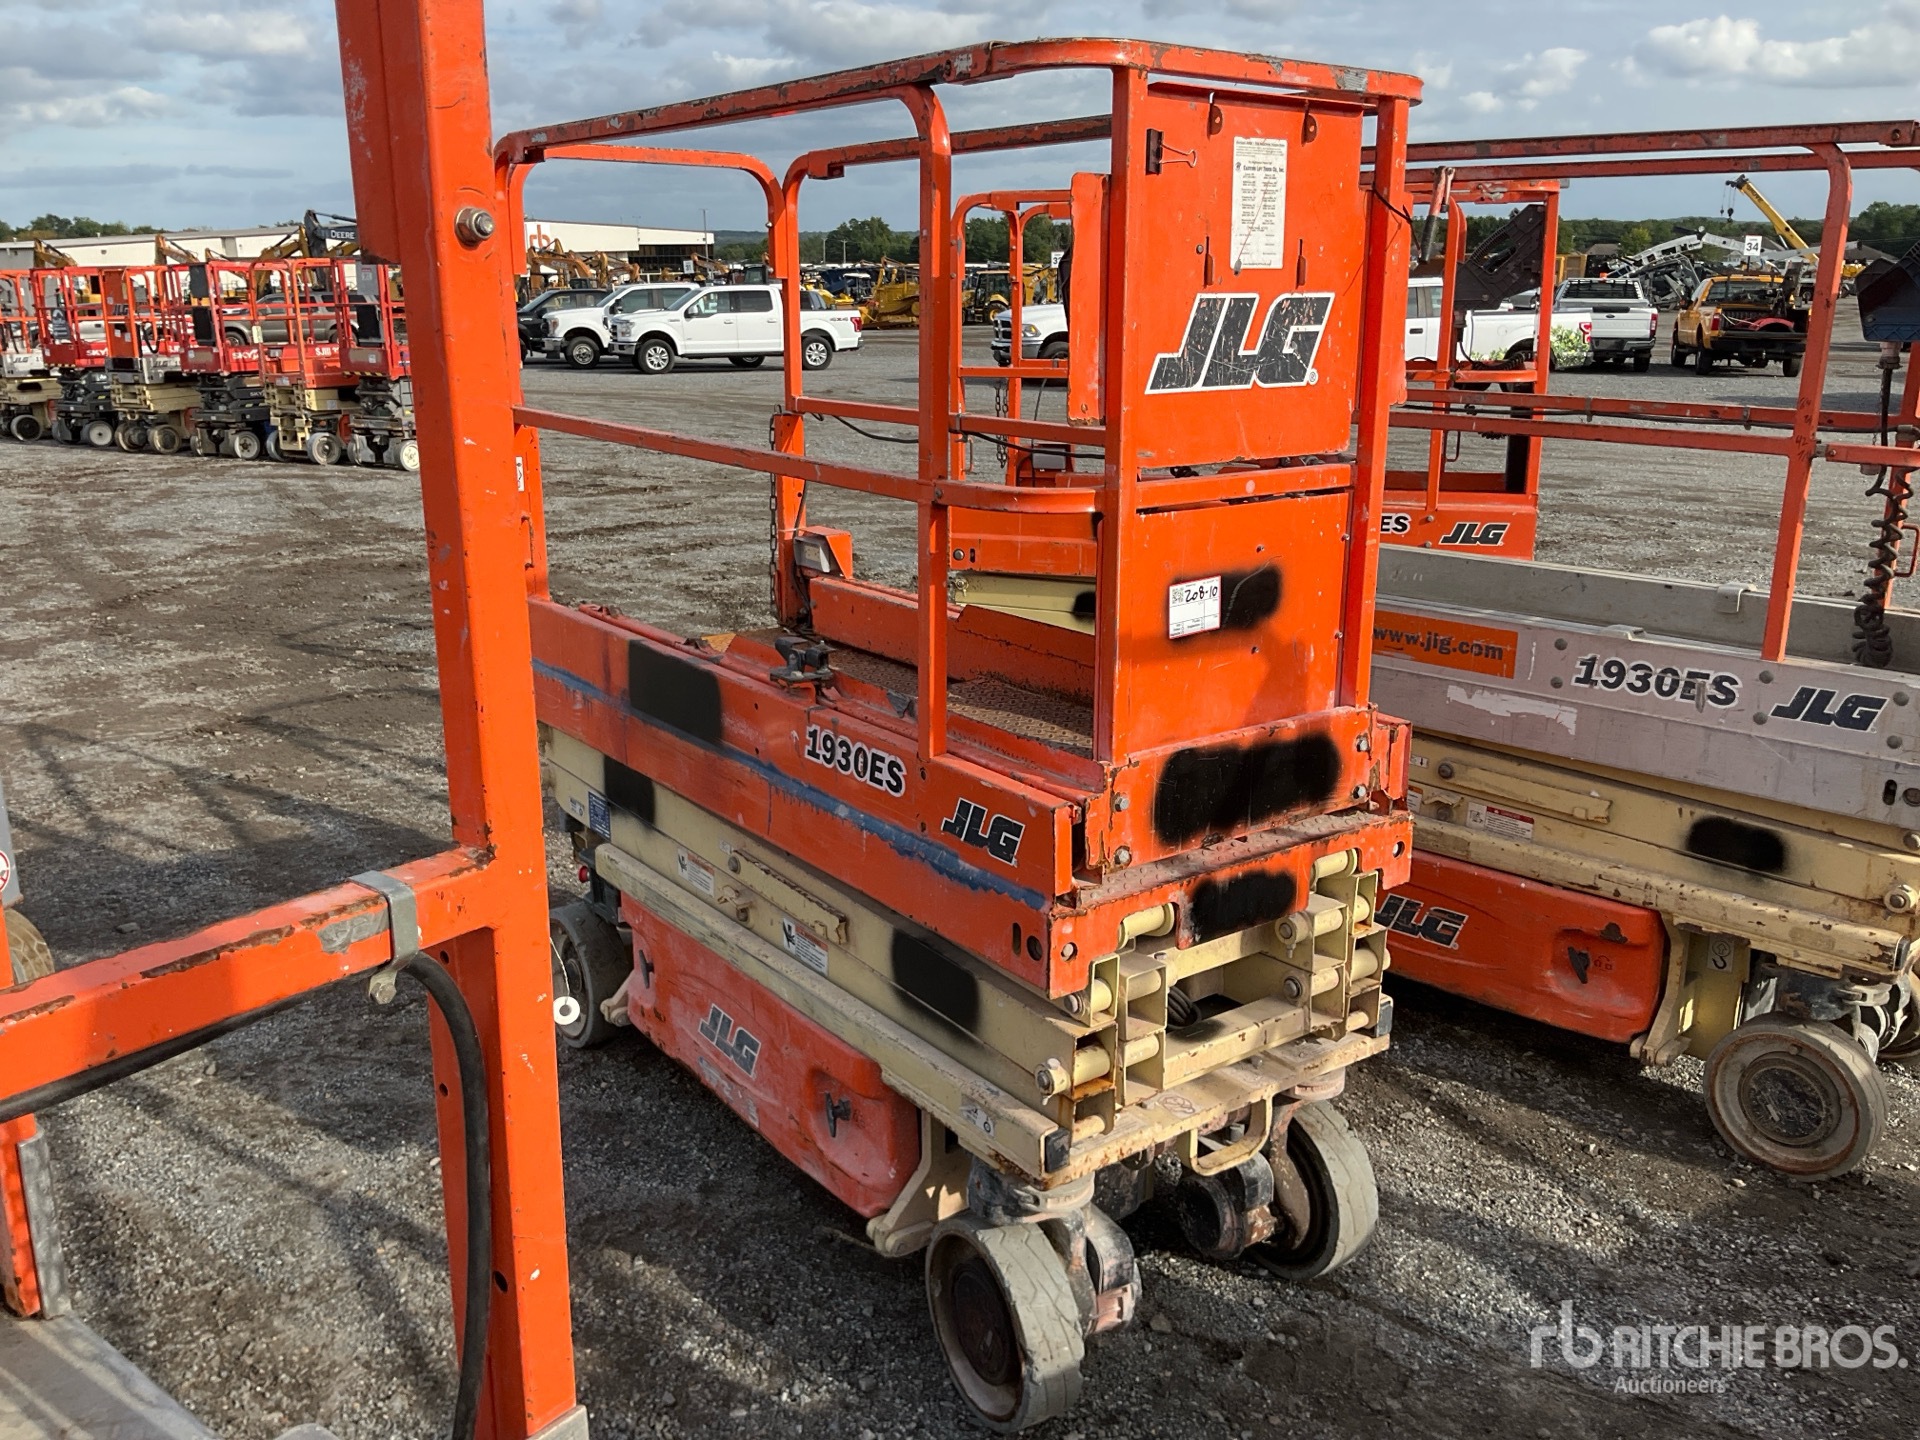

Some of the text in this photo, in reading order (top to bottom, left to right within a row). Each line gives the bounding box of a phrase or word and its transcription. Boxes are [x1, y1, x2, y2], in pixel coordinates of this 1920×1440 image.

[331, 230, 355, 239] DEERE
[1746, 242, 1758, 251] 34
[1145, 293, 1335, 394] JLG
[1381, 513, 1411, 534] ES
[1439, 522, 1510, 546] JLG
[1185, 585, 1218, 602] 208-10
[1373, 627, 1503, 660] www.jlg.com
[1571, 654, 1742, 708] 1930ES
[1769, 686, 1889, 732] JLG
[805, 724, 907, 797] 1930ES
[941, 798, 1025, 866] JLG
[1374, 893, 1469, 949] JLG
[699, 1003, 761, 1078] JLG
